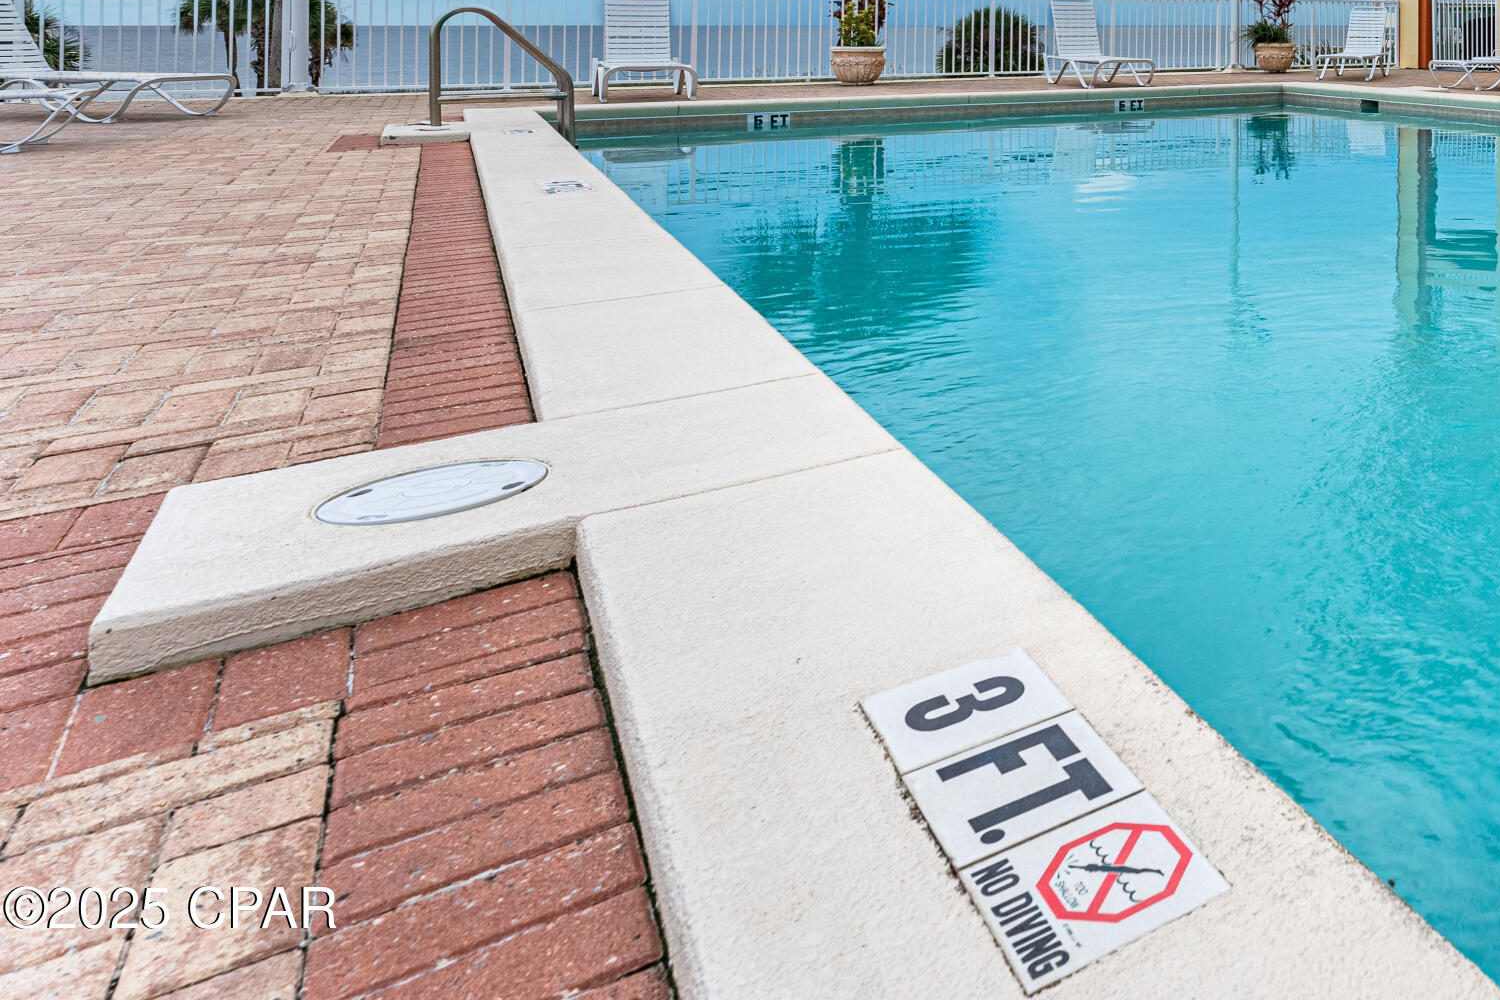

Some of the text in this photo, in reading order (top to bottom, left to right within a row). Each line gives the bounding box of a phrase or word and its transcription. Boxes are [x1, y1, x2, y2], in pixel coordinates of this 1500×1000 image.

[904, 675, 1114, 845] 3 FT.
[970, 858, 1070, 981] NO DIVING
